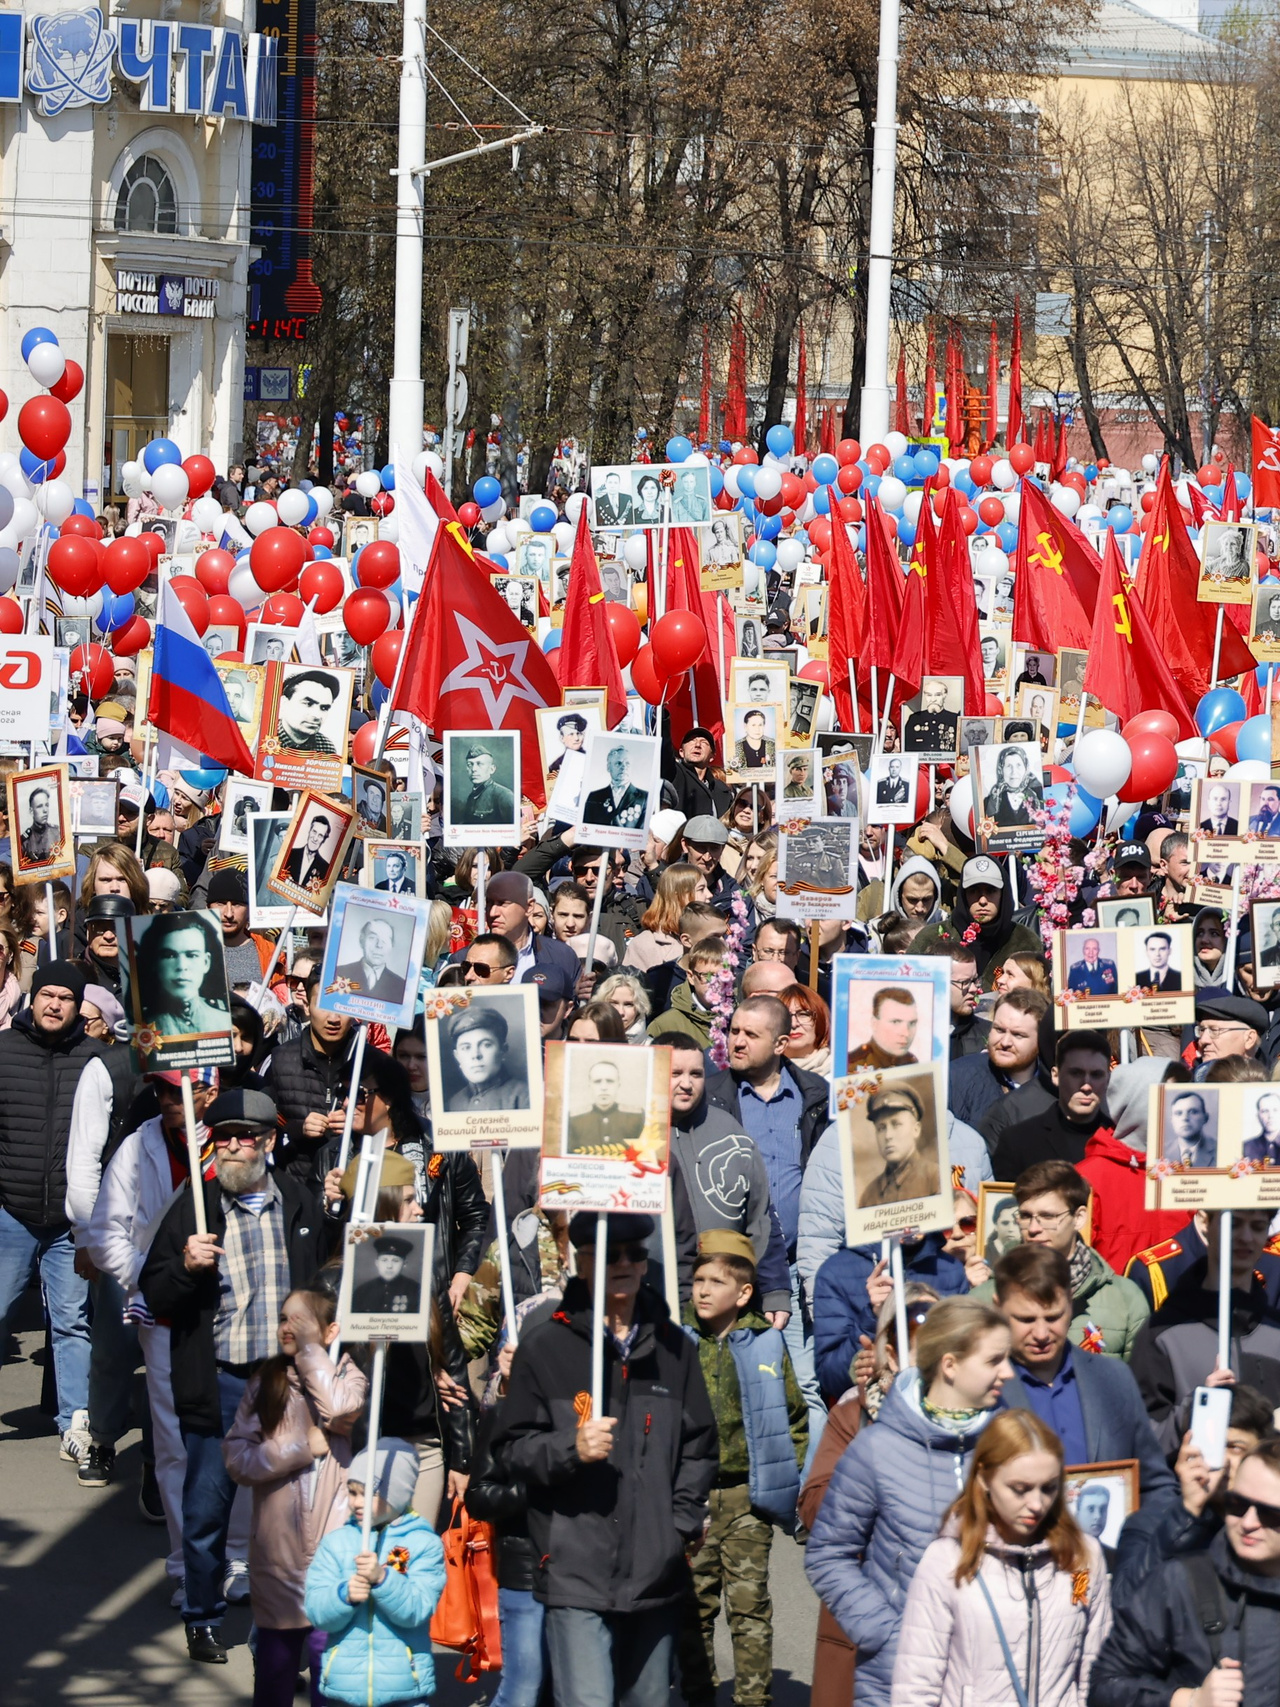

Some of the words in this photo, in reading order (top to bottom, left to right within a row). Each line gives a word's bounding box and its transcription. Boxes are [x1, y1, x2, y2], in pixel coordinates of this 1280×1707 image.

[118, 270, 157, 292] ПОЧТА
[184, 276, 220, 297] ПОЧТА
[117, 293, 160, 315] РОССИИ
[183, 299, 215, 319] БАНК
[304, 759, 341, 769] ЗОРЧЕНКО
[1121, 844, 1145, 858] 20+
[465, 1115, 510, 1125] Селезнёв
[437, 1125, 478, 1137] Василий
[478, 1124, 540, 1135] Михайлович
[631, 1200, 663, 1209] ПОЛК
[873, 1202, 924, 1219] ГРИШАНОВ
[862, 1220, 890, 1232] ИВАН
[889, 1210, 937, 1228] СЕРГЕЕВИЧ
[380, 1324, 419, 1333] Петрович
